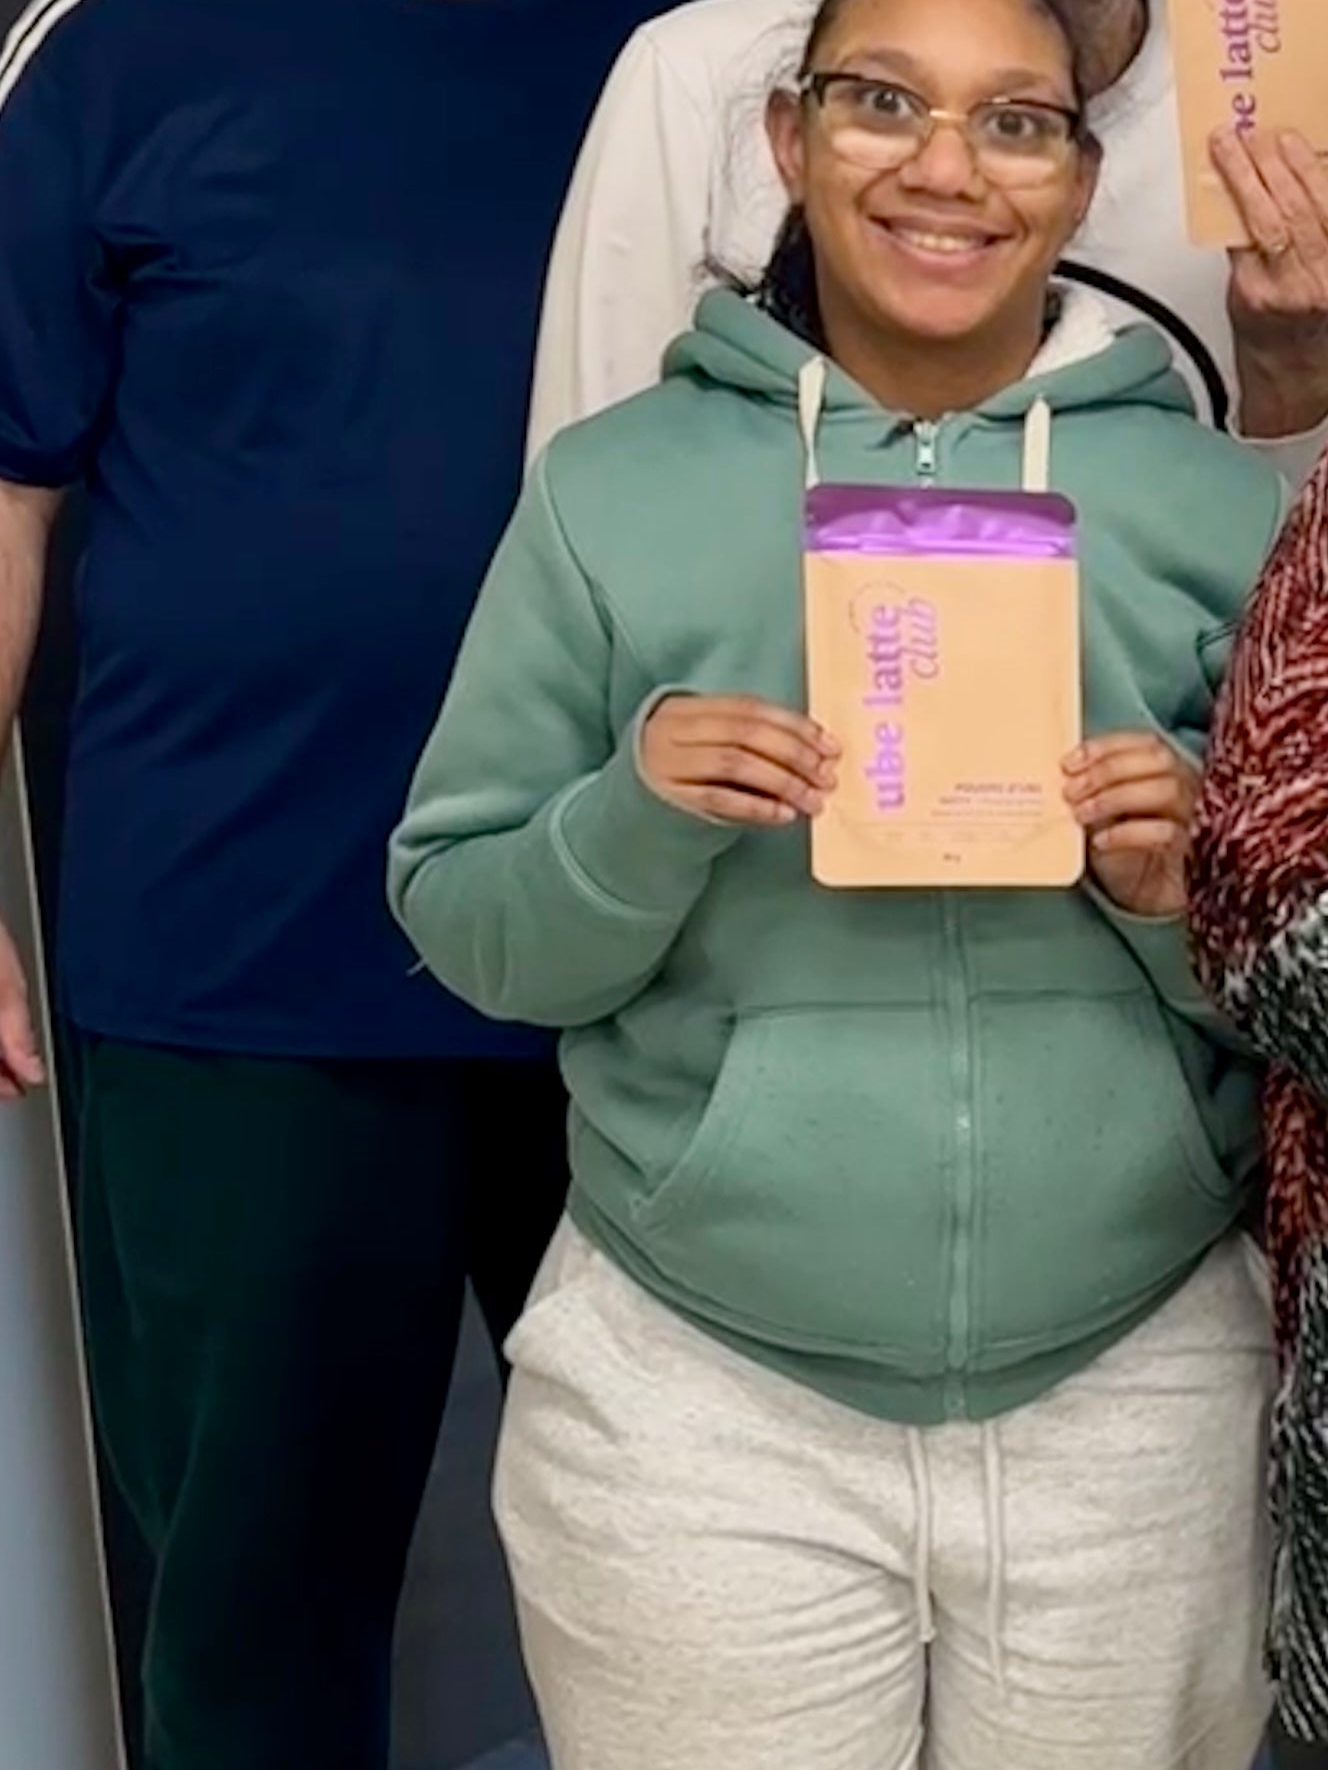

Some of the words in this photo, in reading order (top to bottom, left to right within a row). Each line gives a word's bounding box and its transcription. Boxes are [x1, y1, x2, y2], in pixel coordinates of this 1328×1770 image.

[863, 604, 904, 707] latte
[900, 596, 940, 680] club
[863, 721, 905, 812] ube
